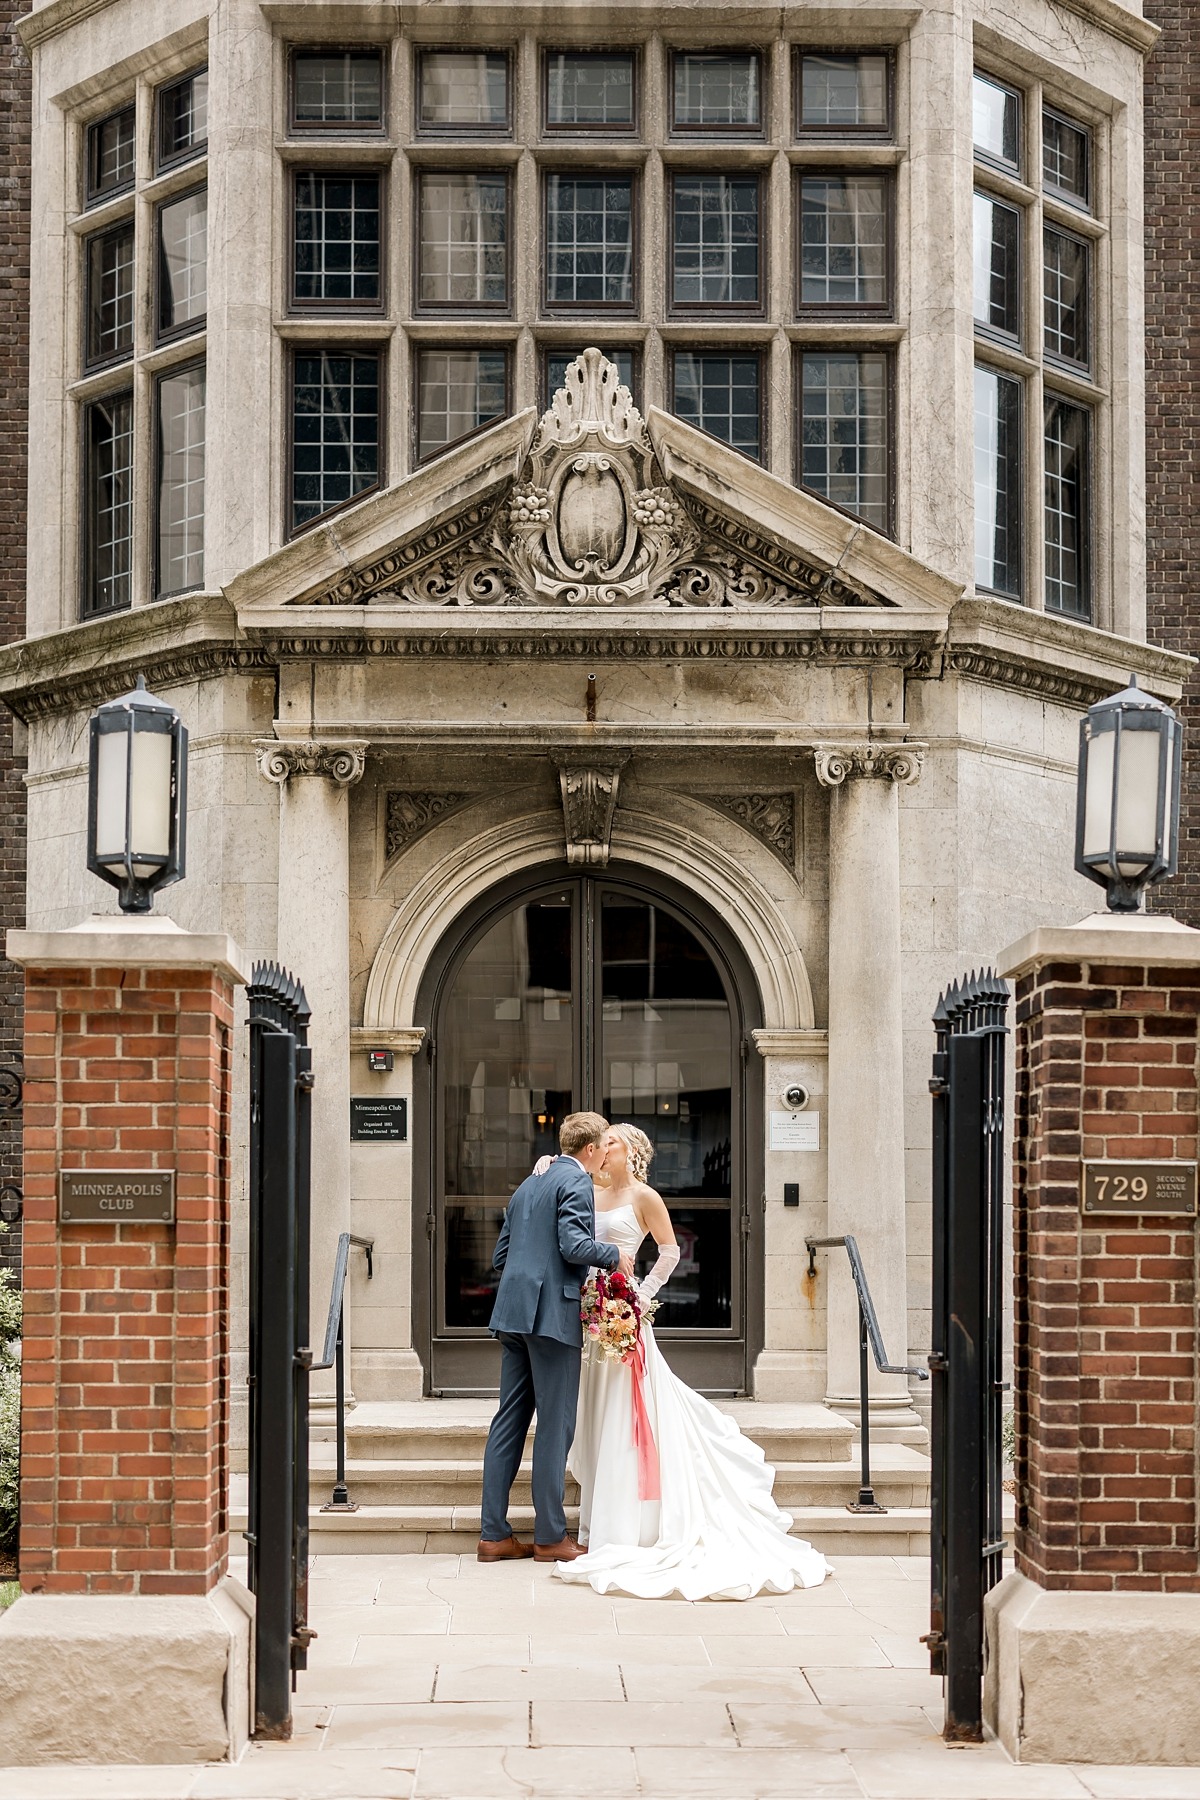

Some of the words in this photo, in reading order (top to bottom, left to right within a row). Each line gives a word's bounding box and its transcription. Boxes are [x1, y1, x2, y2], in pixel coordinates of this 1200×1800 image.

[1155, 1175, 1187, 1183] SECOND
[71, 1184, 163, 1196] MINNEAPOLIS
[1094, 1176, 1148, 1201] 729
[1155, 1183, 1187, 1191] AVENUE
[99, 1198, 135, 1210] CLUB
